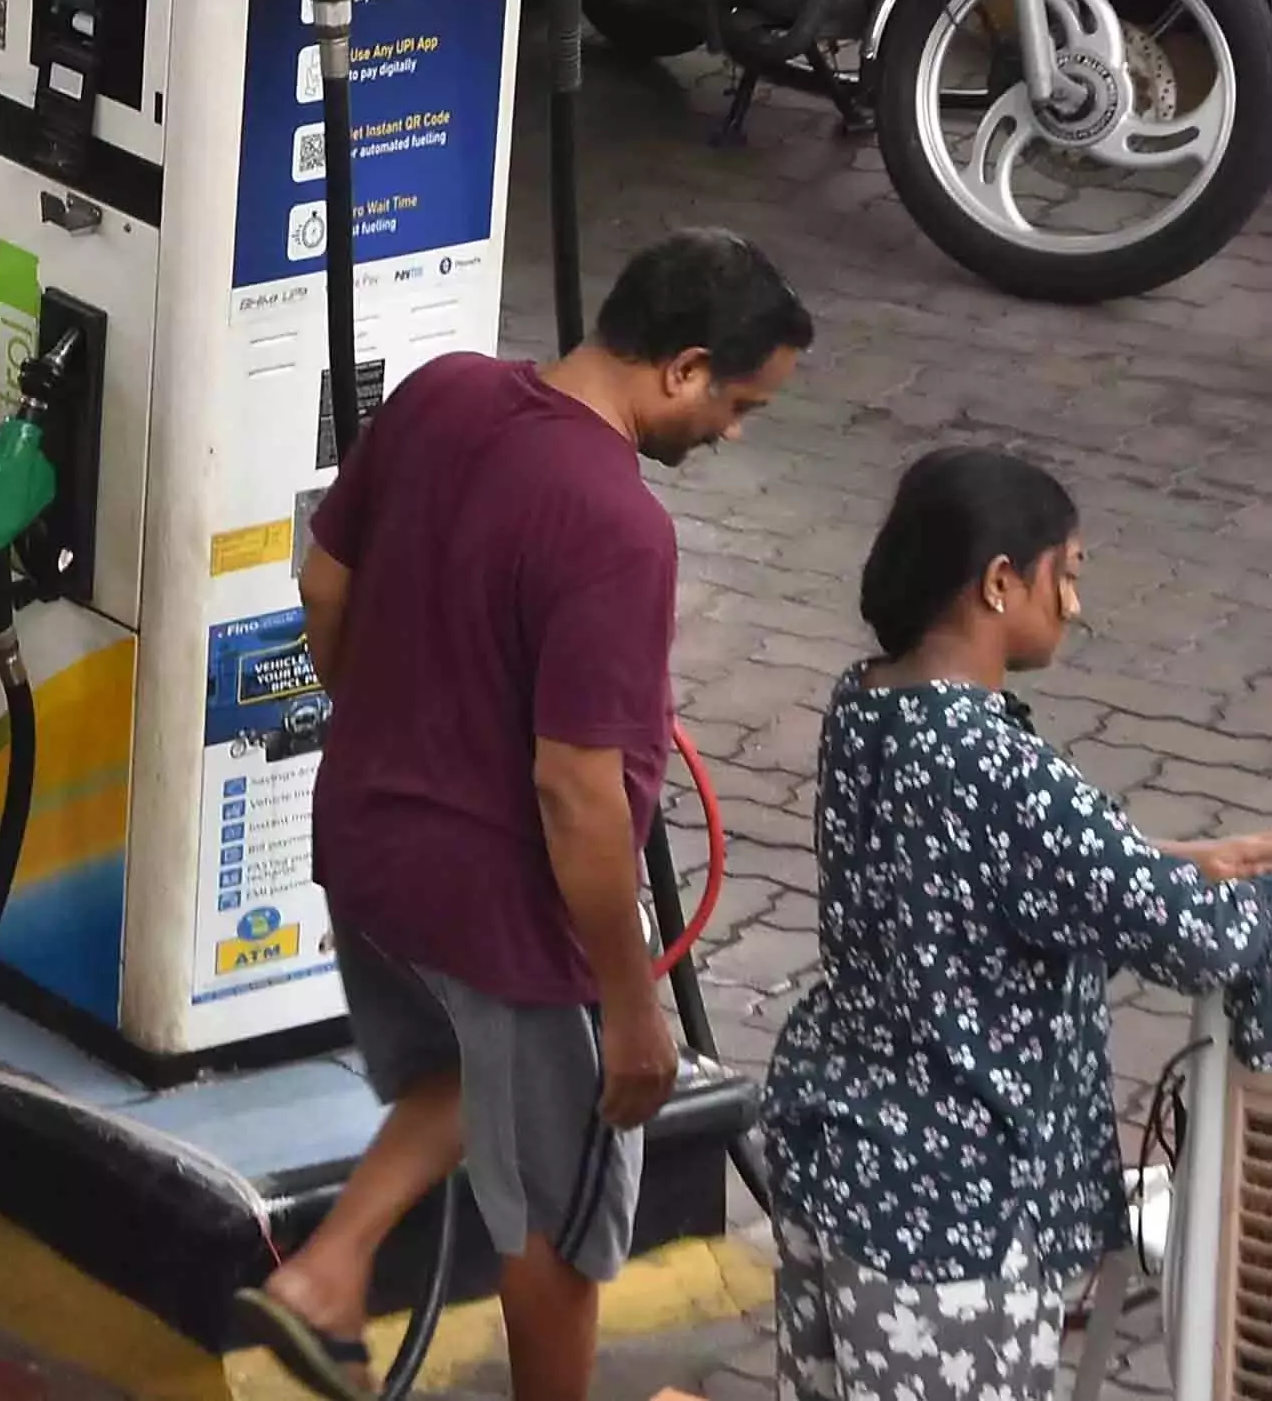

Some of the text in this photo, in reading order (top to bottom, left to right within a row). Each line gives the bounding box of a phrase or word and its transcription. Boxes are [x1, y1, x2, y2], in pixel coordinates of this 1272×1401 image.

[351, 34, 439, 63] Use Any UPI App
[349, 56, 418, 83] to pay digitally
[365, 118, 403, 138] Instant
[404, 114, 421, 131] QR
[423, 109, 450, 128] Code
[359, 136, 410, 160] automated
[411, 130, 447, 149] fuelling
[366, 198, 391, 216] Wait
[393, 193, 418, 210] Time
[361, 217, 397, 236] fuelling
[0, 316, 35, 408] trol
[226, 621, 260, 637] Fino
[254, 653, 307, 673] VEHICLE
[257, 668, 292, 685] YOUR
[235, 943, 281, 968] ATM
